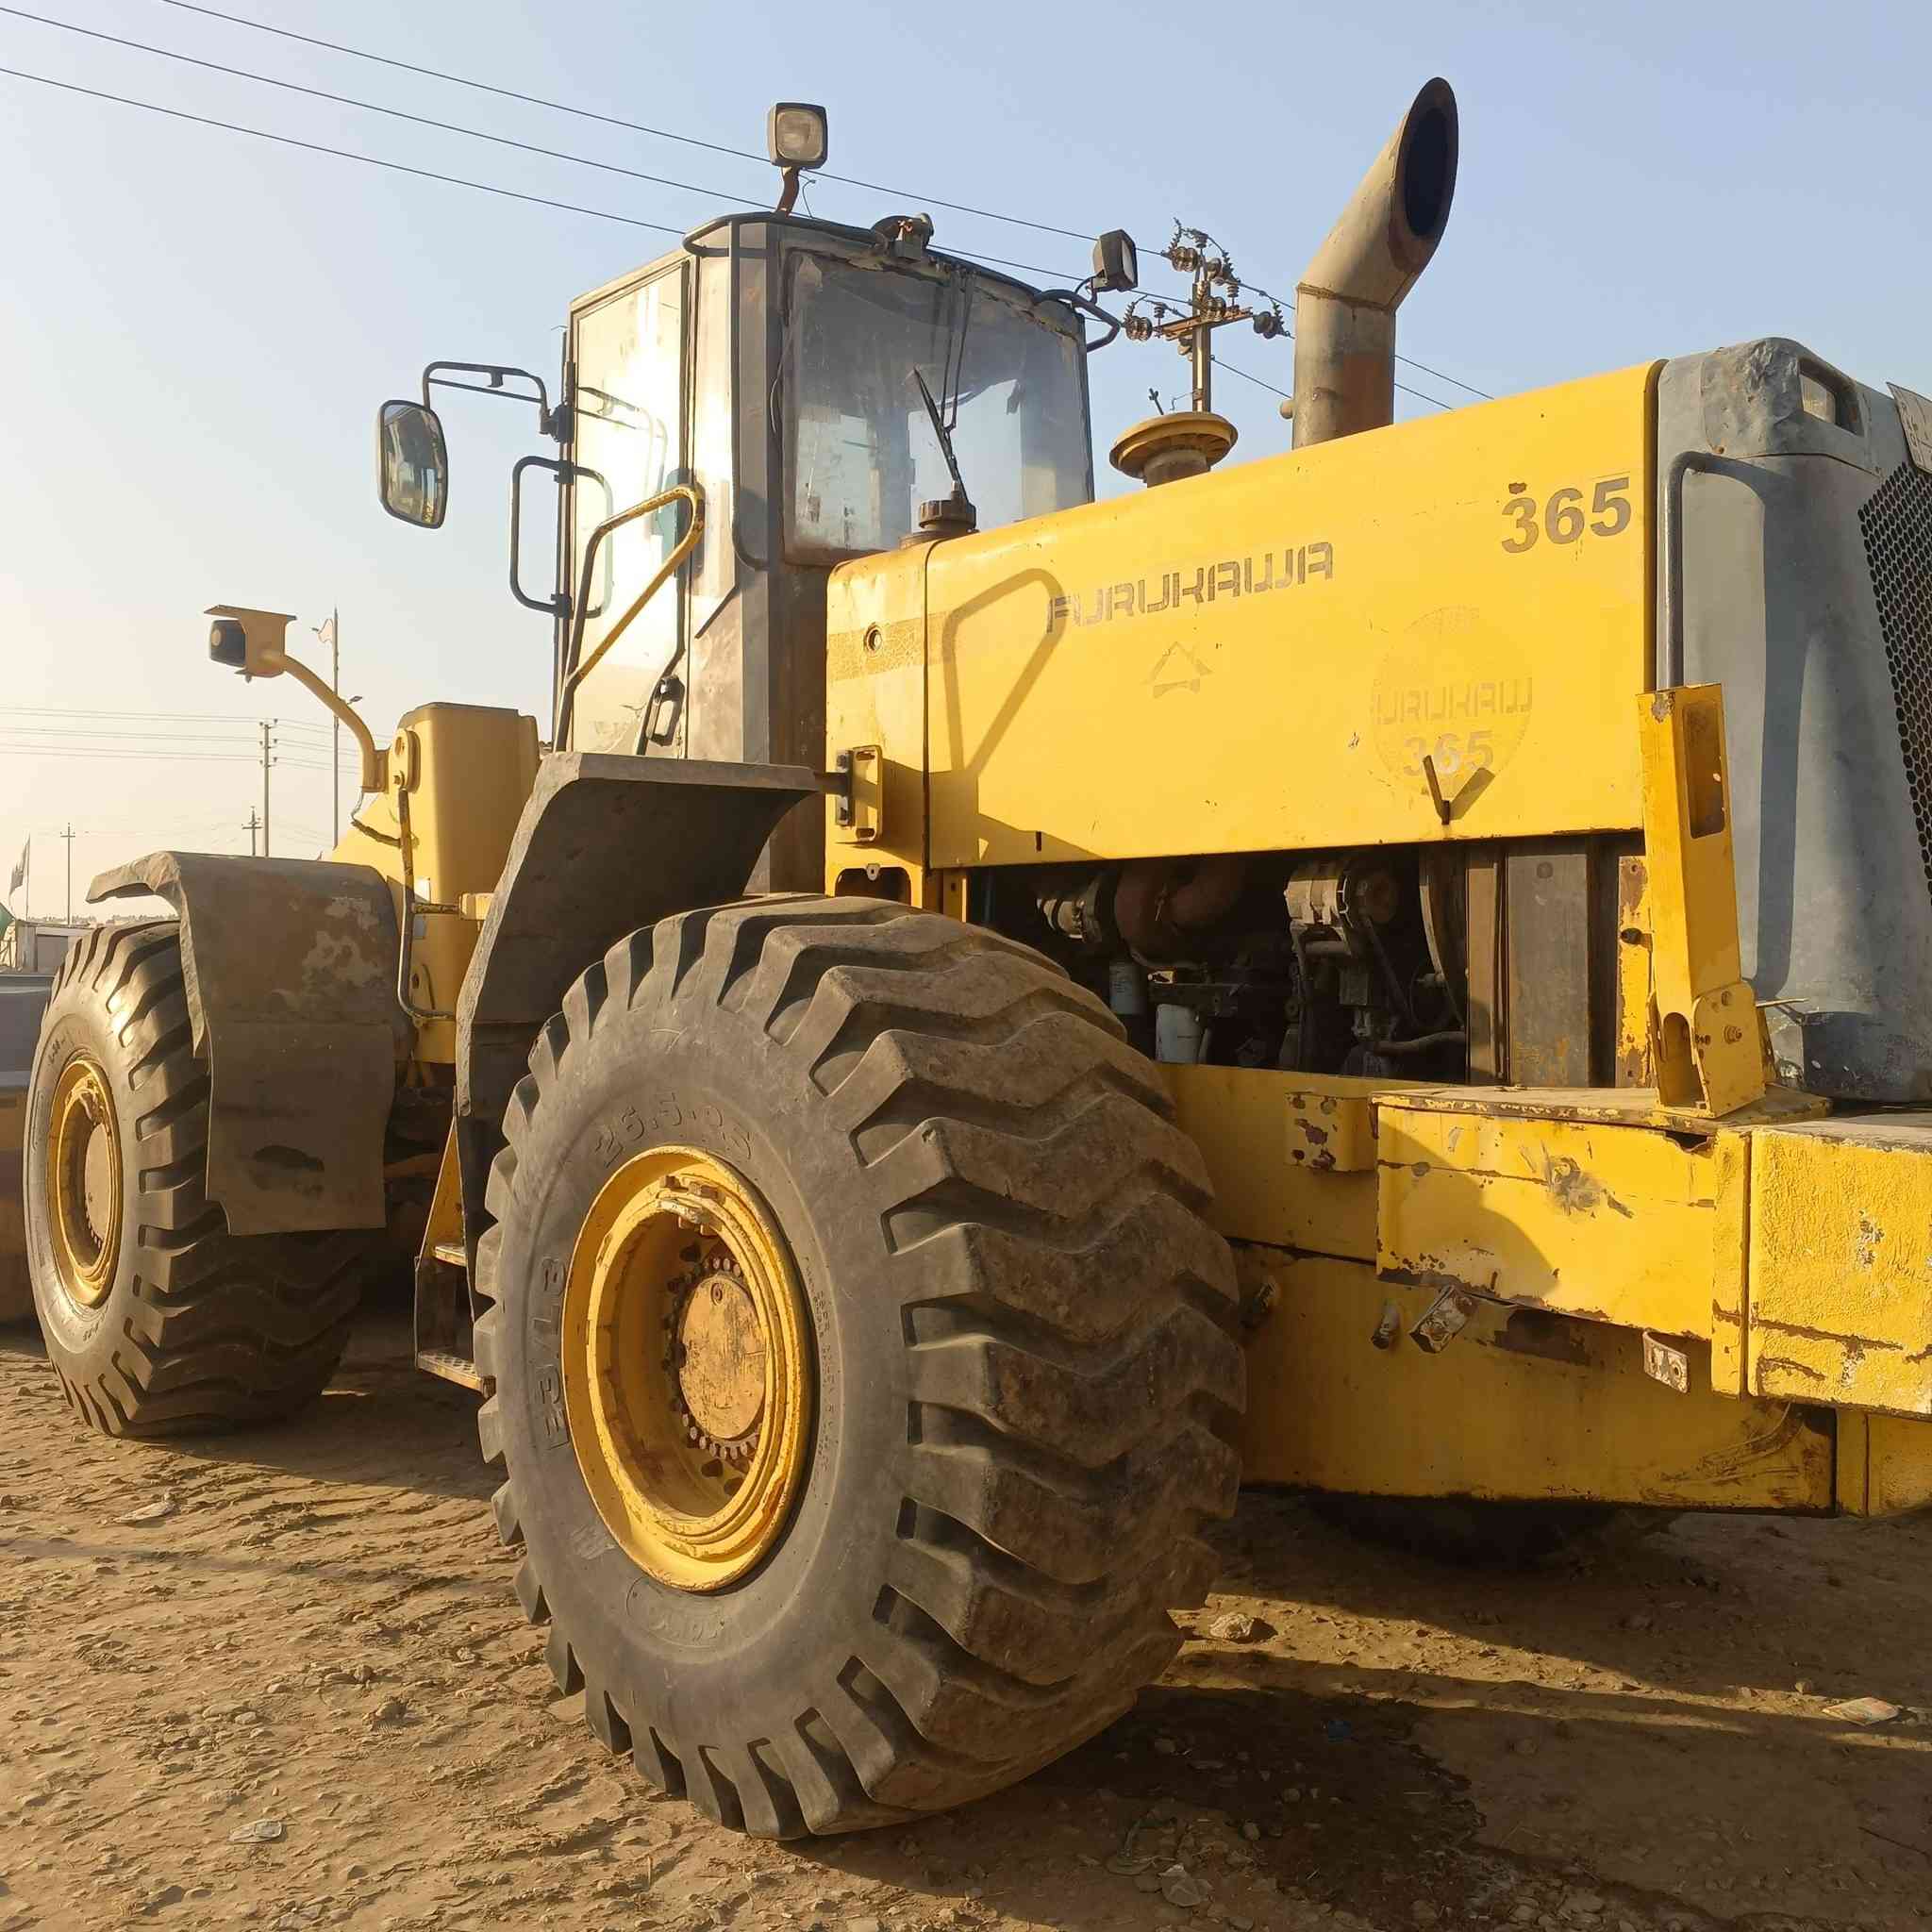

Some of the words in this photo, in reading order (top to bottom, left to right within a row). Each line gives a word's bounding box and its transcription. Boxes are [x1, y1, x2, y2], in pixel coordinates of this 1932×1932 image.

[1502, 476, 1631, 553] 365
[1046, 541, 1333, 634] FURUKAWA
[1404, 730, 1493, 776] 365
